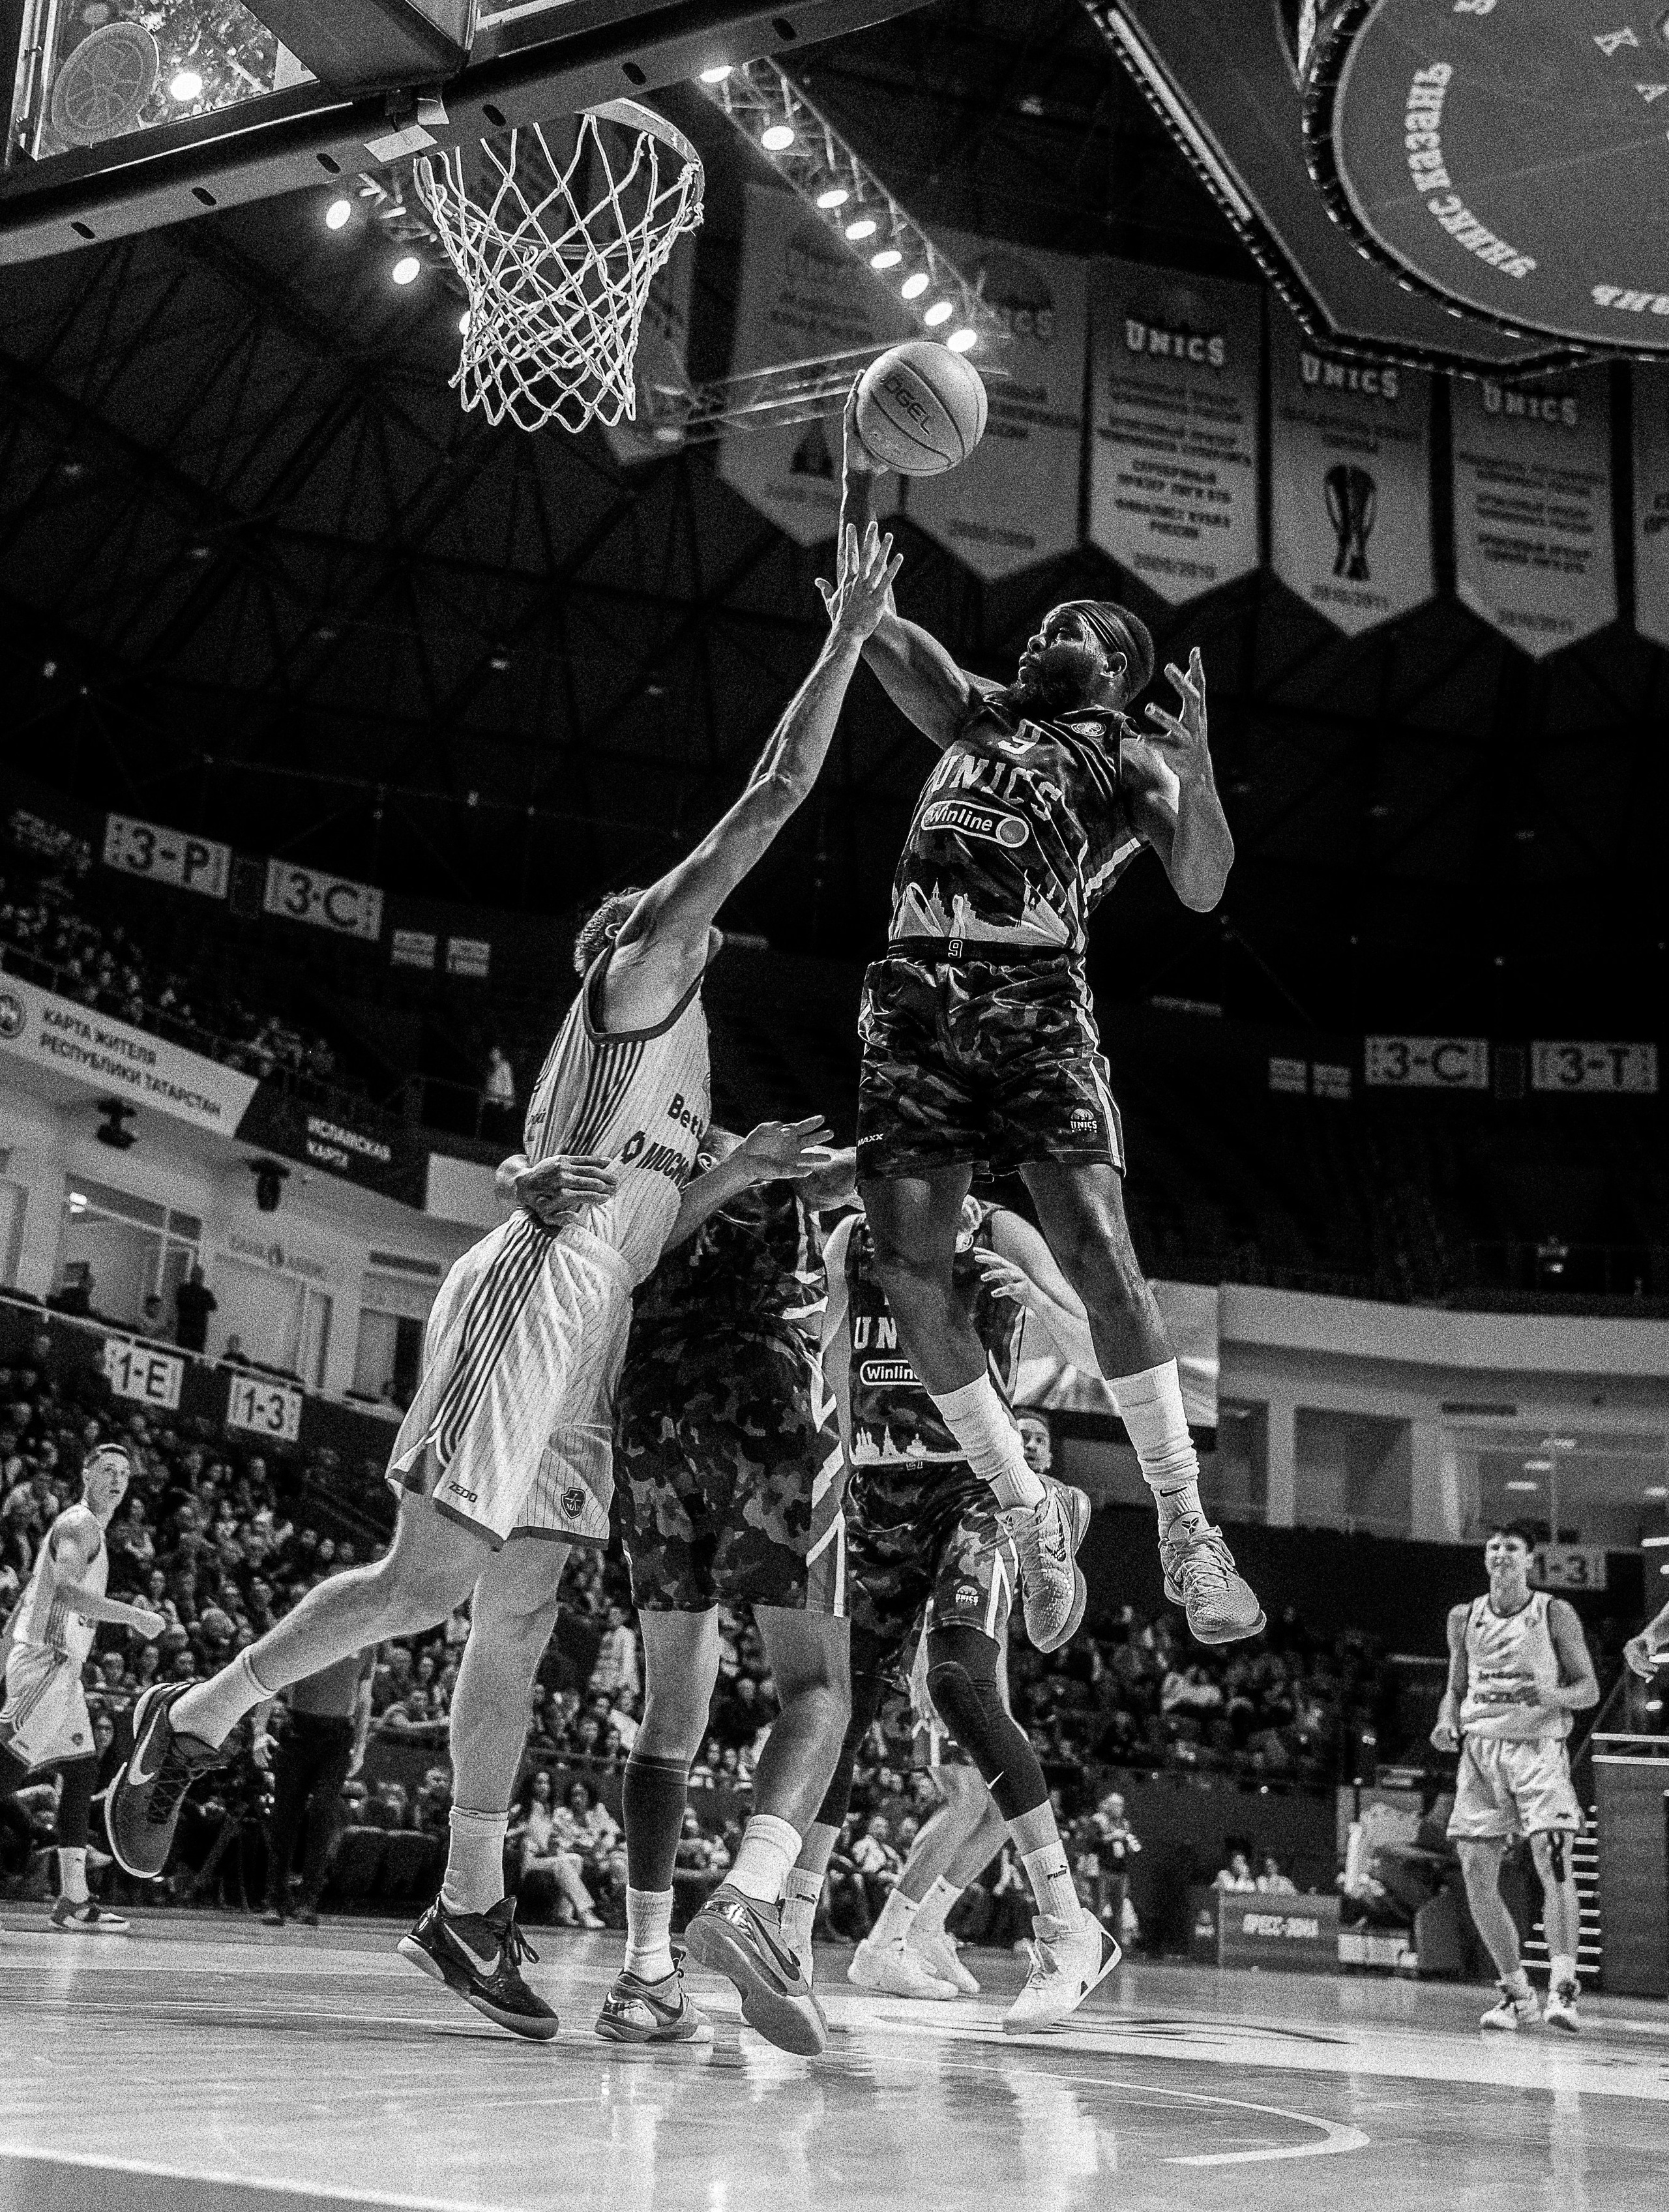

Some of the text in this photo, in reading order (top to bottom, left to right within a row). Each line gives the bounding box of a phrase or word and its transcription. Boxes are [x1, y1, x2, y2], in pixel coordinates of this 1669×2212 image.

[1125, 318, 1226, 368] UNICS
[1300, 350, 1398, 399] UNICS
[1483, 378, 1578, 426] UNICS
[930, 754, 1063, 821] UNICS
[927, 806, 993, 831] Winline
[948, 939, 963, 958] 9
[42, 1009, 156, 1066] КАРТА ЖИТЕЛЯ
[40, 1032, 222, 1117] РЕСПУБЛИКИ ТАТАРСТАН
[1070, 1119, 1097, 1129] UNICS
[635, 1142, 690, 1190] МОСК
[853, 1316, 898, 1349] UN
[866, 1366, 920, 1380] Winlin
[955, 1593, 979, 1606] UNICS
